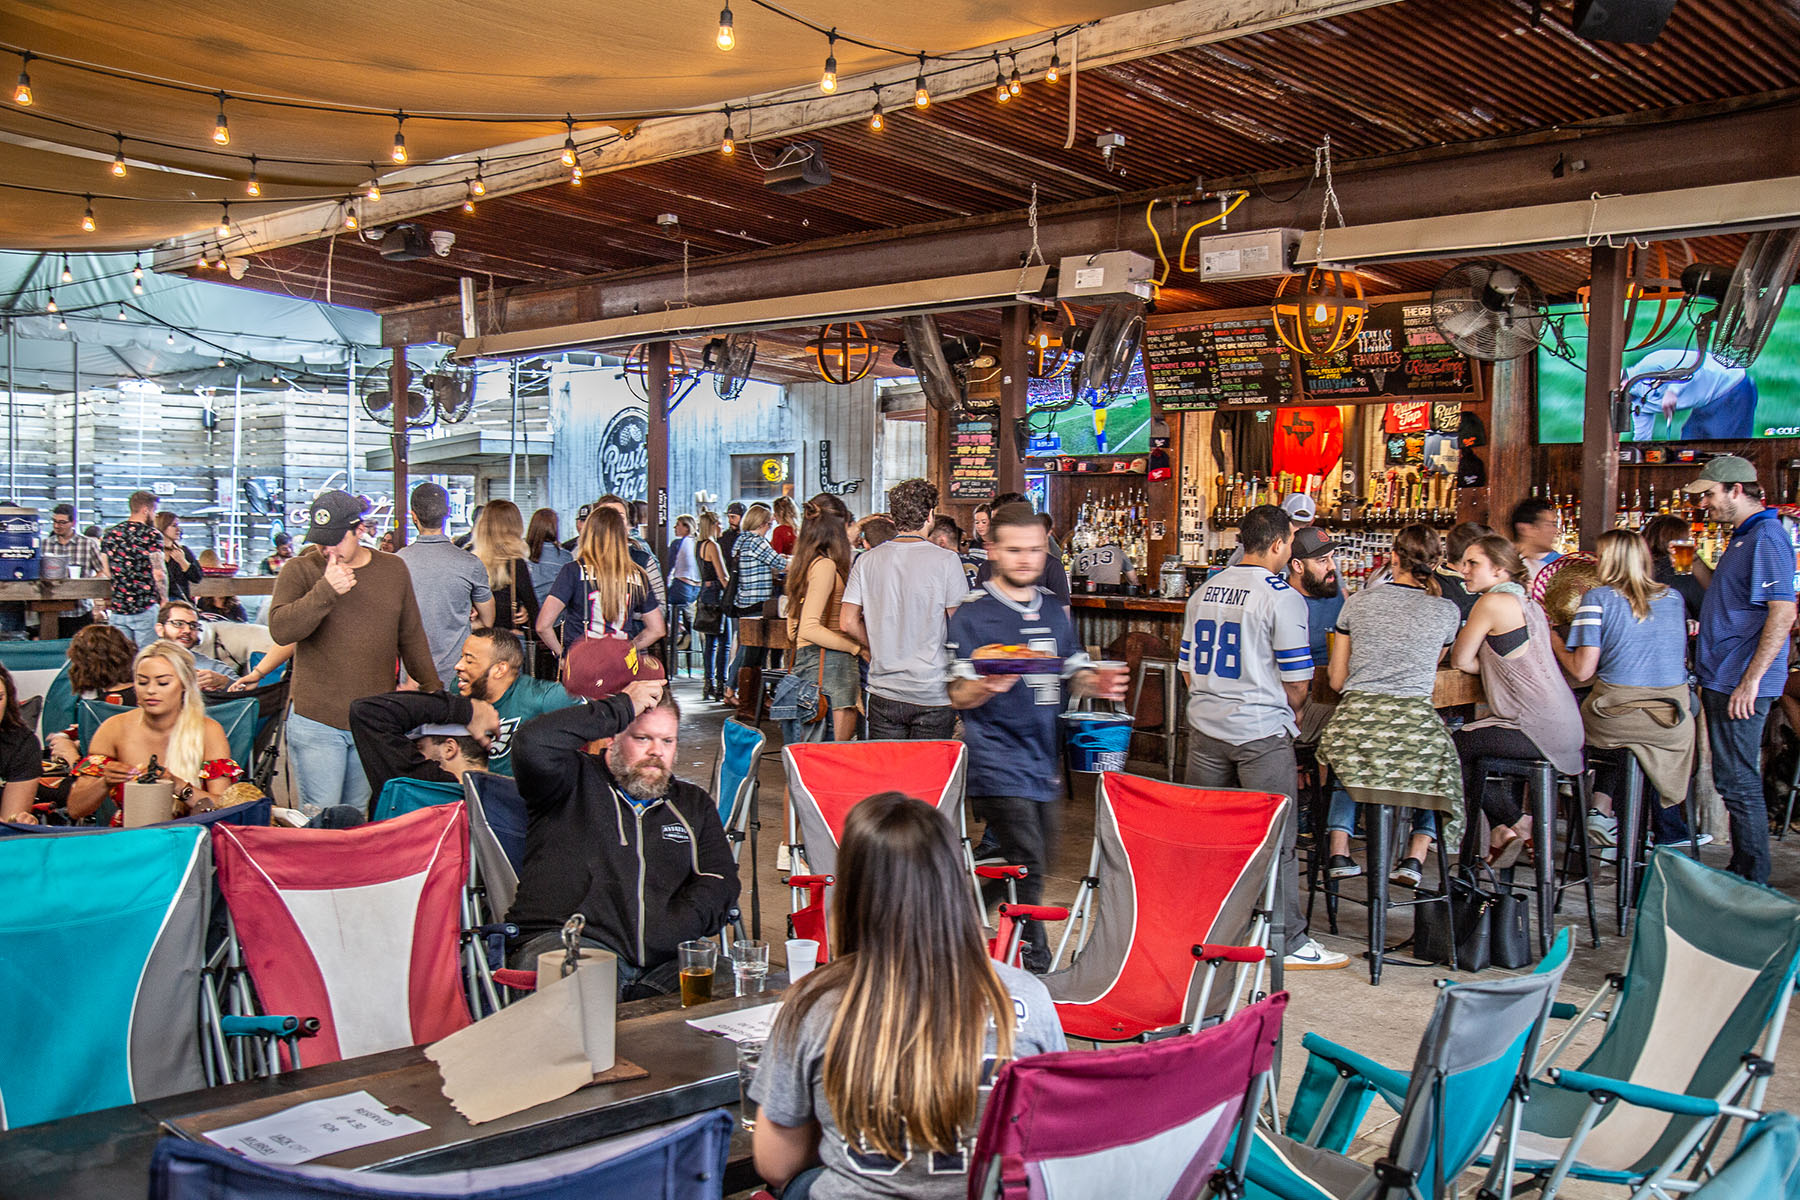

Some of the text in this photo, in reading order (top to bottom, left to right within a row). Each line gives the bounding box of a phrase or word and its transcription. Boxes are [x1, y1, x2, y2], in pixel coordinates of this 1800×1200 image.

[1356, 329, 1393, 353] TEXAS
[1351, 351, 1402, 366] FAVORITES
[1399, 409, 1423, 426] Tap
[1776, 426, 1800, 435] GOLF
[1079, 549, 1114, 572] 613
[1202, 586, 1251, 606] BRYANT
[1194, 619, 1242, 680] 88
[354, 1107, 394, 1127] RESERVED
[320, 1122, 340, 1133] FOR
